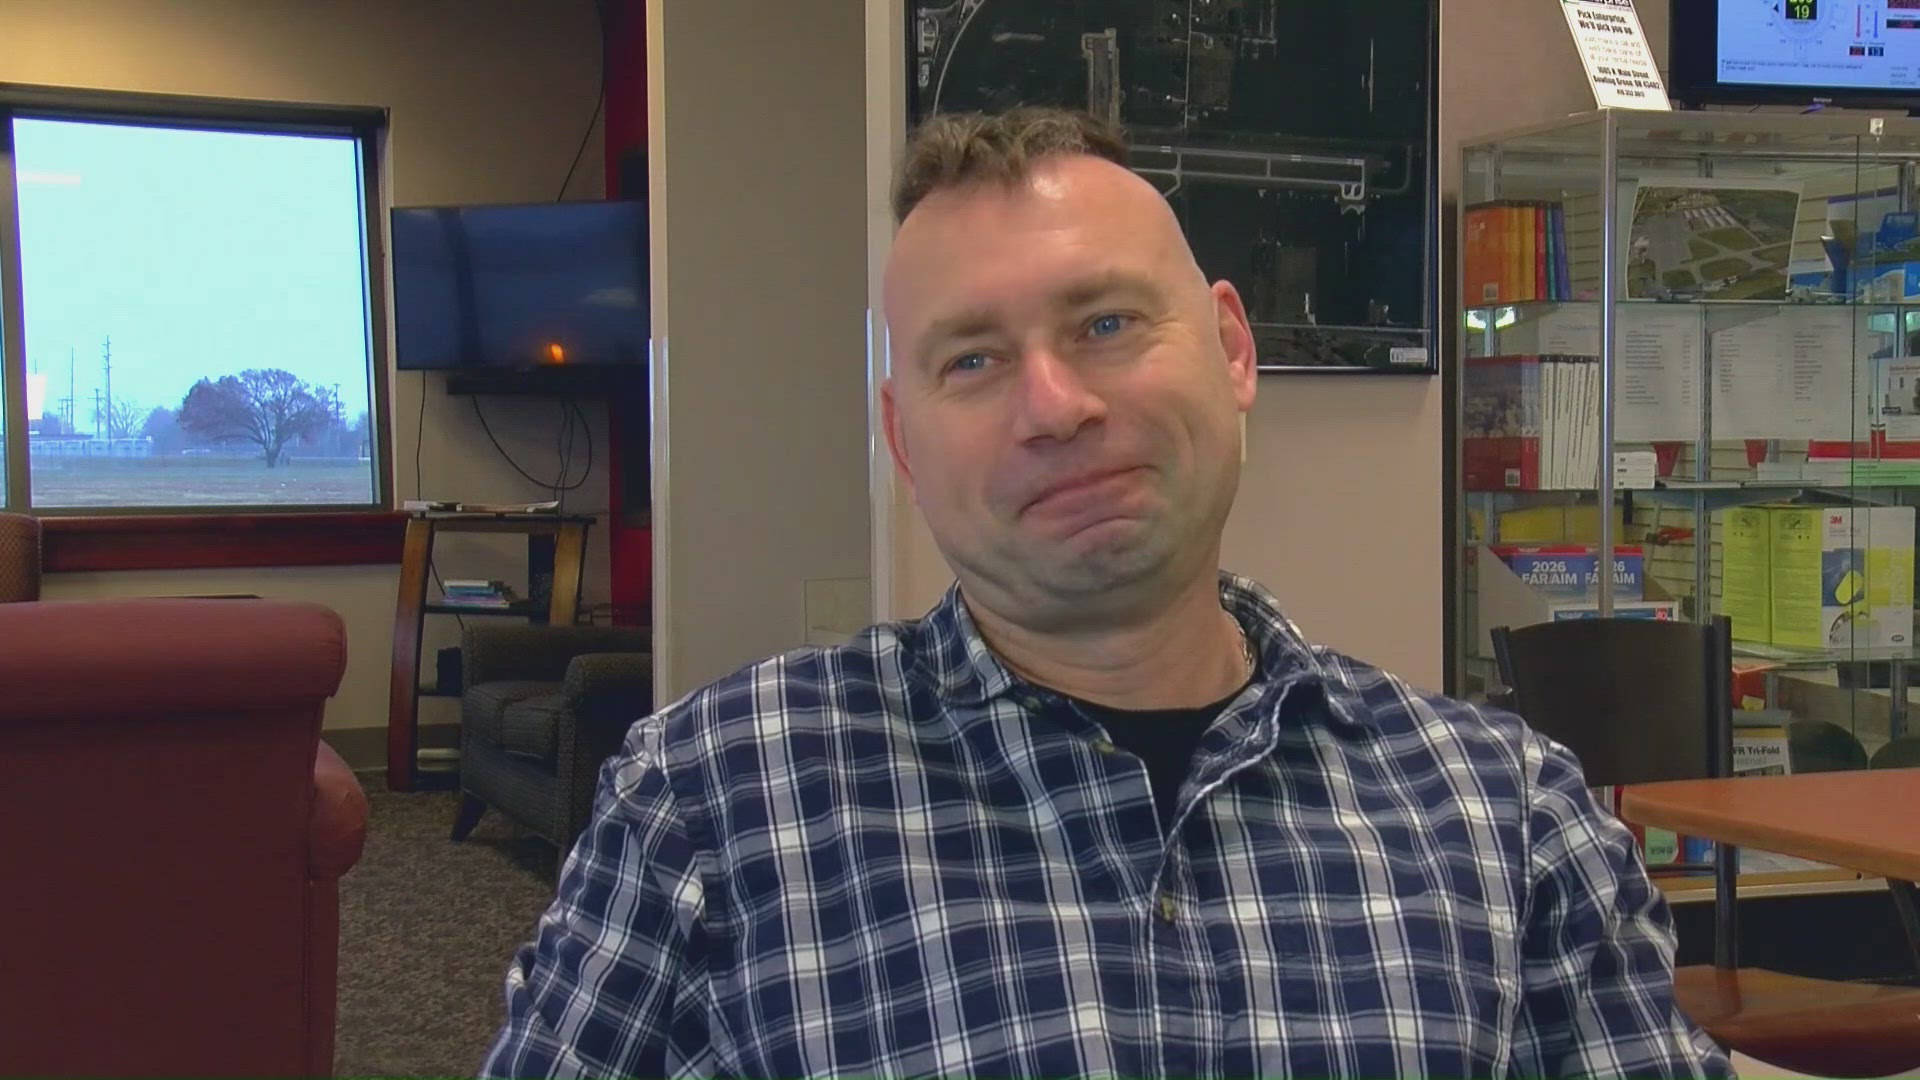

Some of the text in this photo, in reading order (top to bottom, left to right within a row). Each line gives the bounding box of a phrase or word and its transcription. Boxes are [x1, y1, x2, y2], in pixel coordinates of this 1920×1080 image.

[1577, 9, 1592, 19] Pick
[1794, 4, 1809, 19] 19
[1596, 22, 1610, 32] pick
[1611, 25, 1623, 34] you
[1830, 516, 1842, 524] 3M
[1532, 561, 1567, 572] 2026
